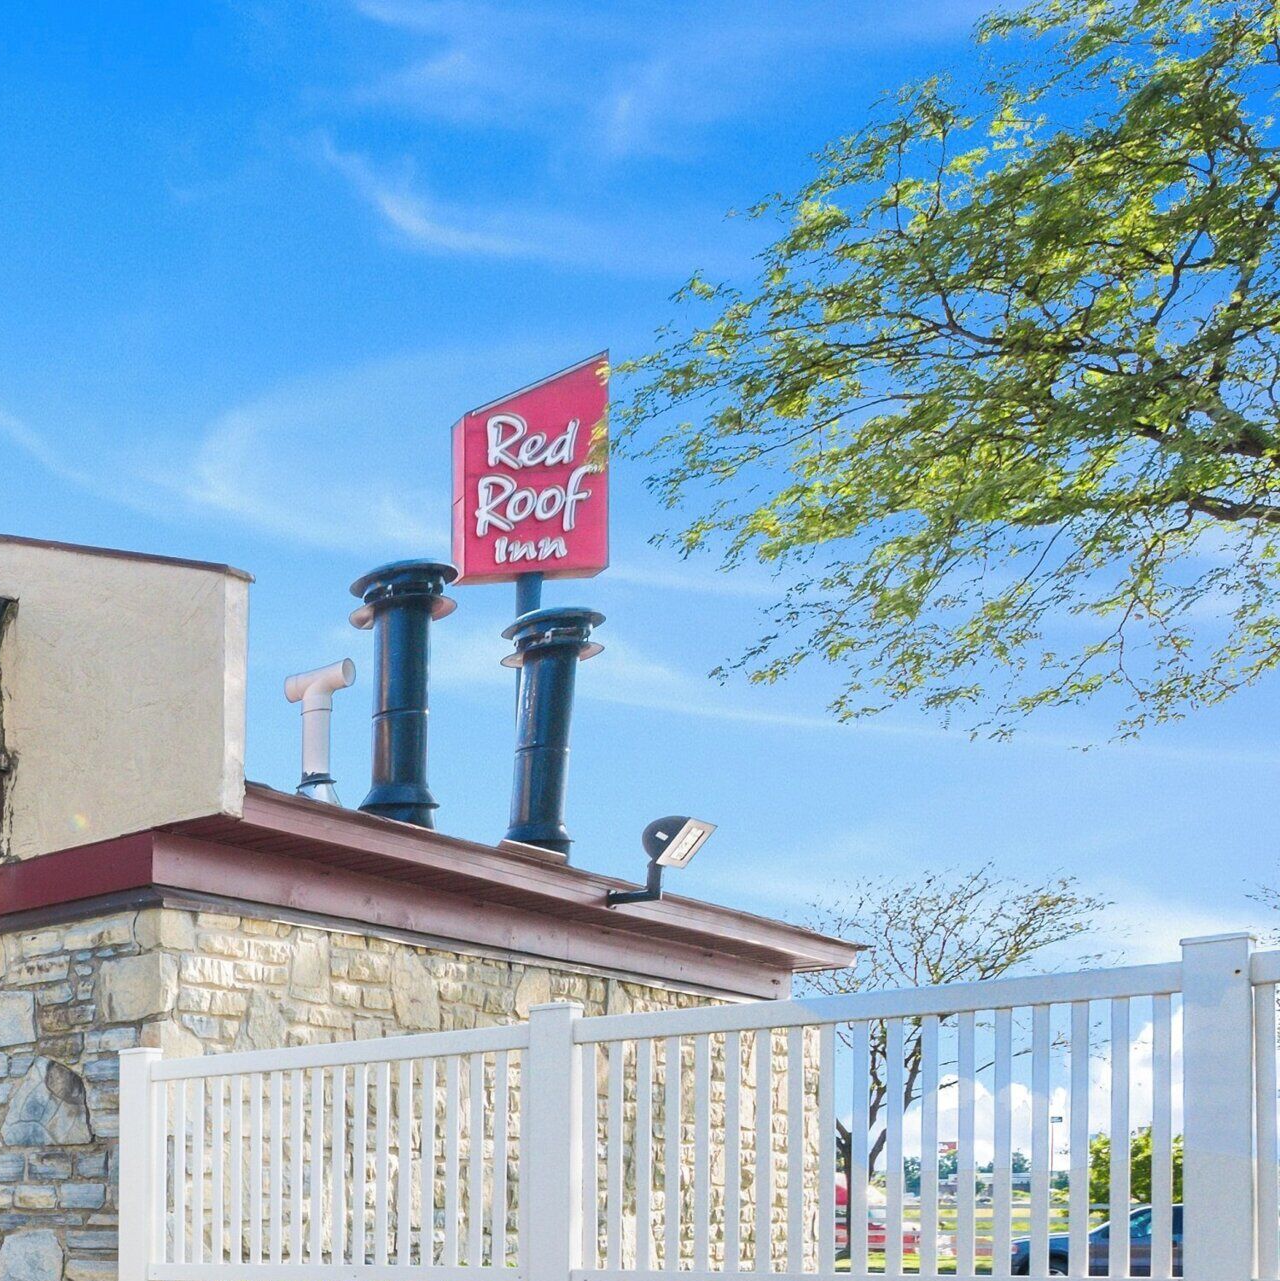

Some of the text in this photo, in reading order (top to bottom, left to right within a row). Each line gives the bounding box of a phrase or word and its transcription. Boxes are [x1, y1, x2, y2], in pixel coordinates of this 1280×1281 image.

[486, 412, 580, 470] Red
[475, 465, 602, 537] Roof
[494, 535, 567, 565] Inn
